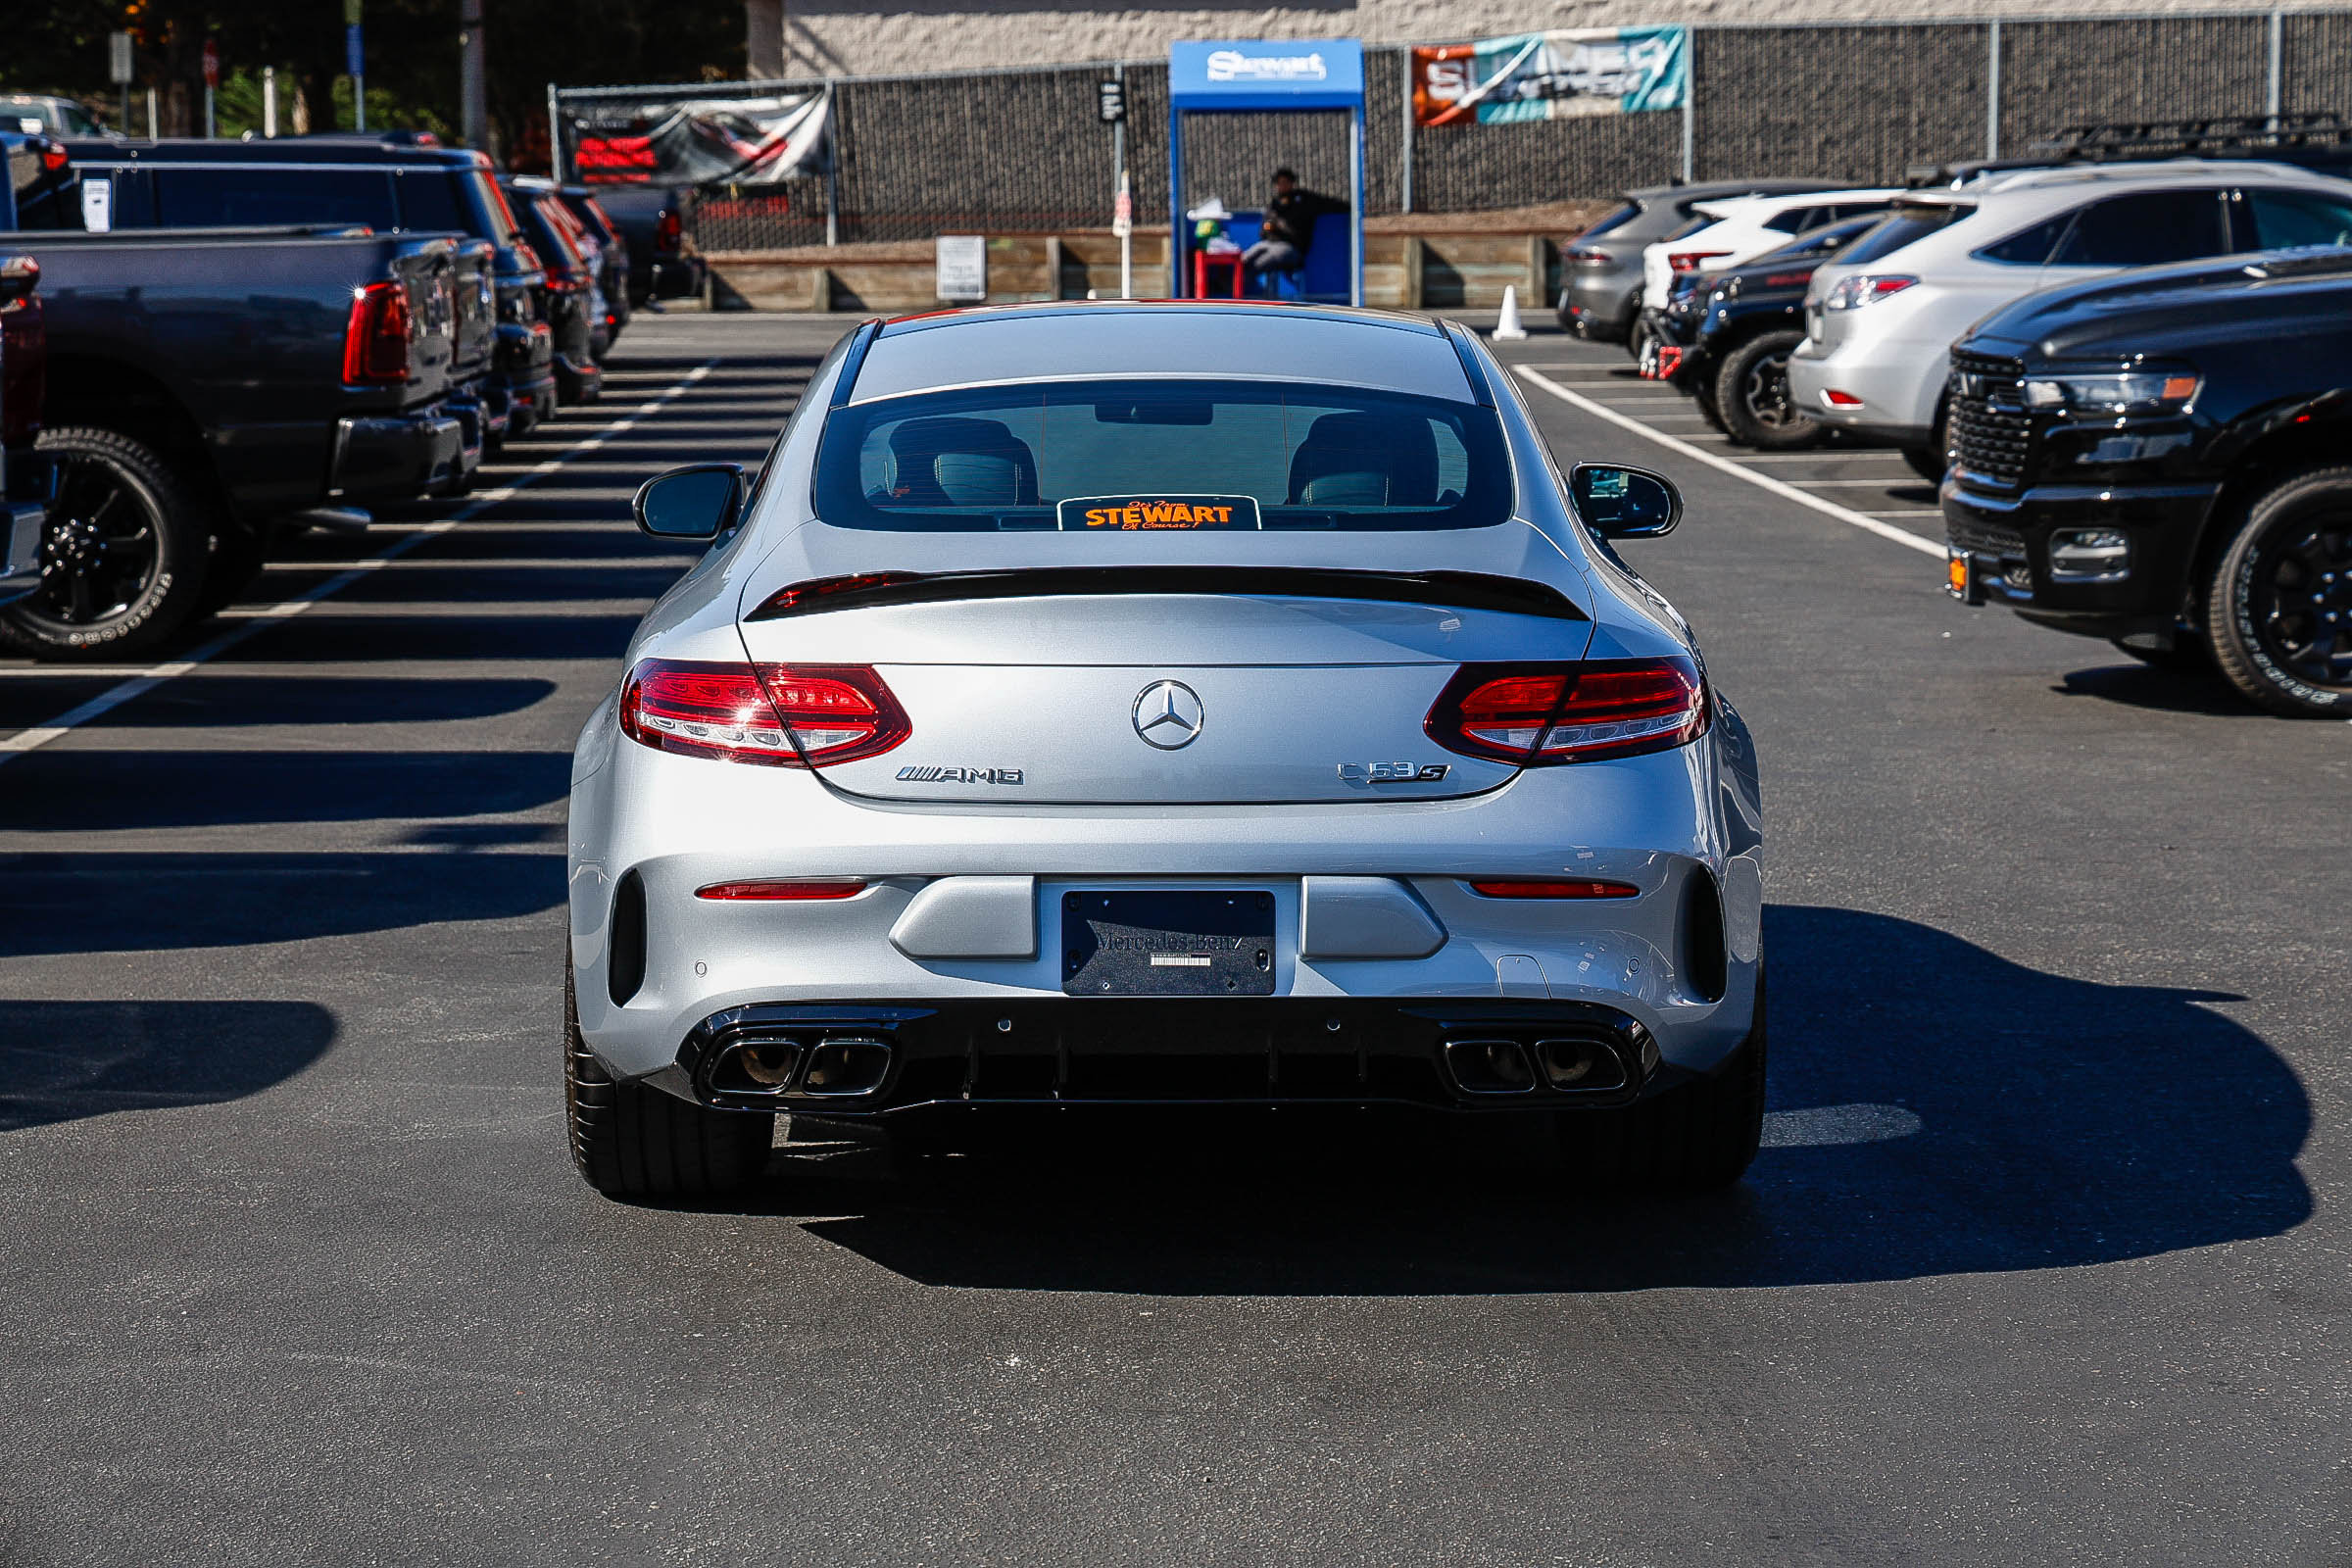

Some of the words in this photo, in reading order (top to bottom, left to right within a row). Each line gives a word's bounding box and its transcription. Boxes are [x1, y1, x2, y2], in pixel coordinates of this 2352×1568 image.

[1085, 506, 1234, 526] STEWART
[937, 766, 1024, 785] AMG
[1097, 932, 1243, 951] Mercedes-Benz
